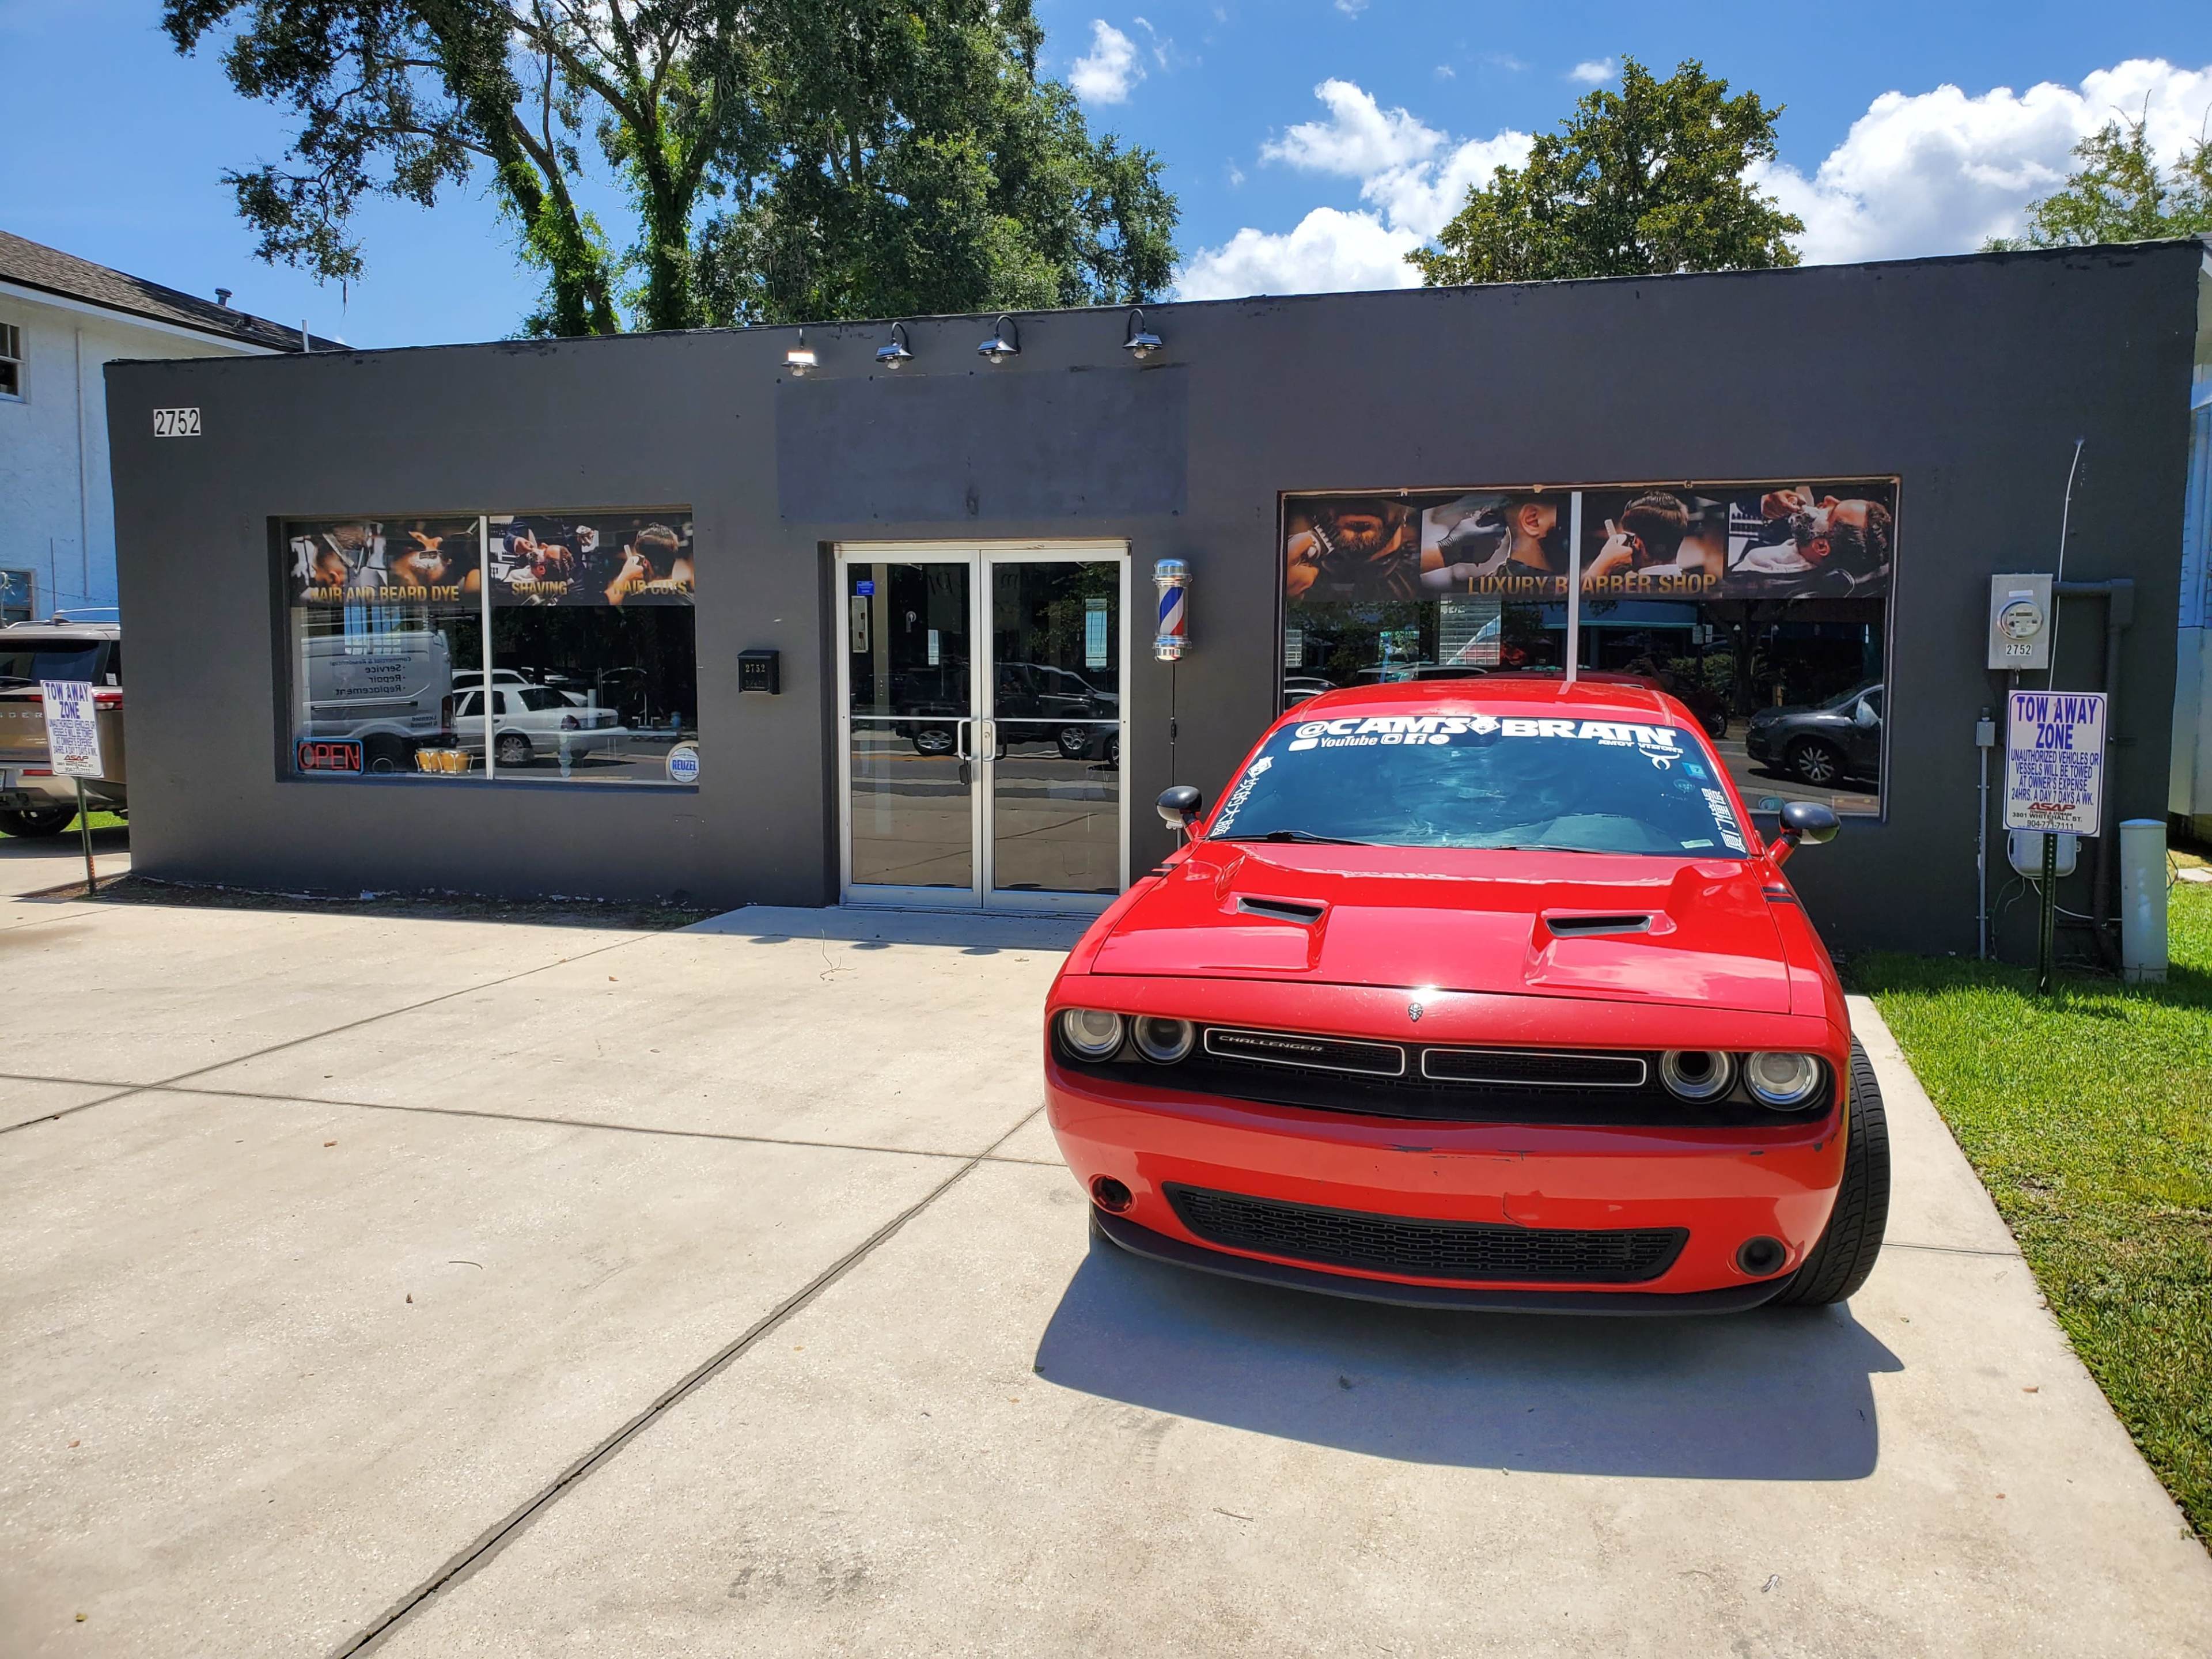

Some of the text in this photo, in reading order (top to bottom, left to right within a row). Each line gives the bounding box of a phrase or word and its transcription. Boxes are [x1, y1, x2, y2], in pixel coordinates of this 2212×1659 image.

[155, 409, 200, 435] 2752
[511, 581, 567, 596] SHAVING
[613, 580, 687, 595] HAIR CUTS
[1468, 576, 1548, 594] LUXURY
[1658, 573, 1717, 594] SHOP
[309, 585, 460, 603] HAIR AND BEARD DYE
[2006, 645, 2031, 655] 2752
[745, 664, 766, 673] 2752
[46, 683, 88, 702] TOW AWAY
[59, 700, 80, 719] ZONE
[2017, 696, 2097, 724] TOW AWAY
[1320, 734, 1378, 748] YouTube
[1501, 719, 1677, 747] BRAIN
[2036, 723, 2074, 749] ZONE
[298, 743, 361, 770] OPEN
[2011, 749, 2099, 766] UNAUTHORIZED VEHICLES OR
[672, 759, 698, 771] REUZEL
[2016, 762, 2093, 778] VESSELS WILL BE TOWED
[2018, 776, 2088, 792] AT OWNER'S EXPENSE
[2012, 787, 2094, 806] 24HRS. A DAY 7 DAYS A WK.
[2027, 801, 2076, 812] ASAP
[2027, 819, 2074, 830] 904-771-7111
[2029, 813, 2071, 821] WHITEHALL
[1218, 1036, 1323, 1052] CHALLENGER
